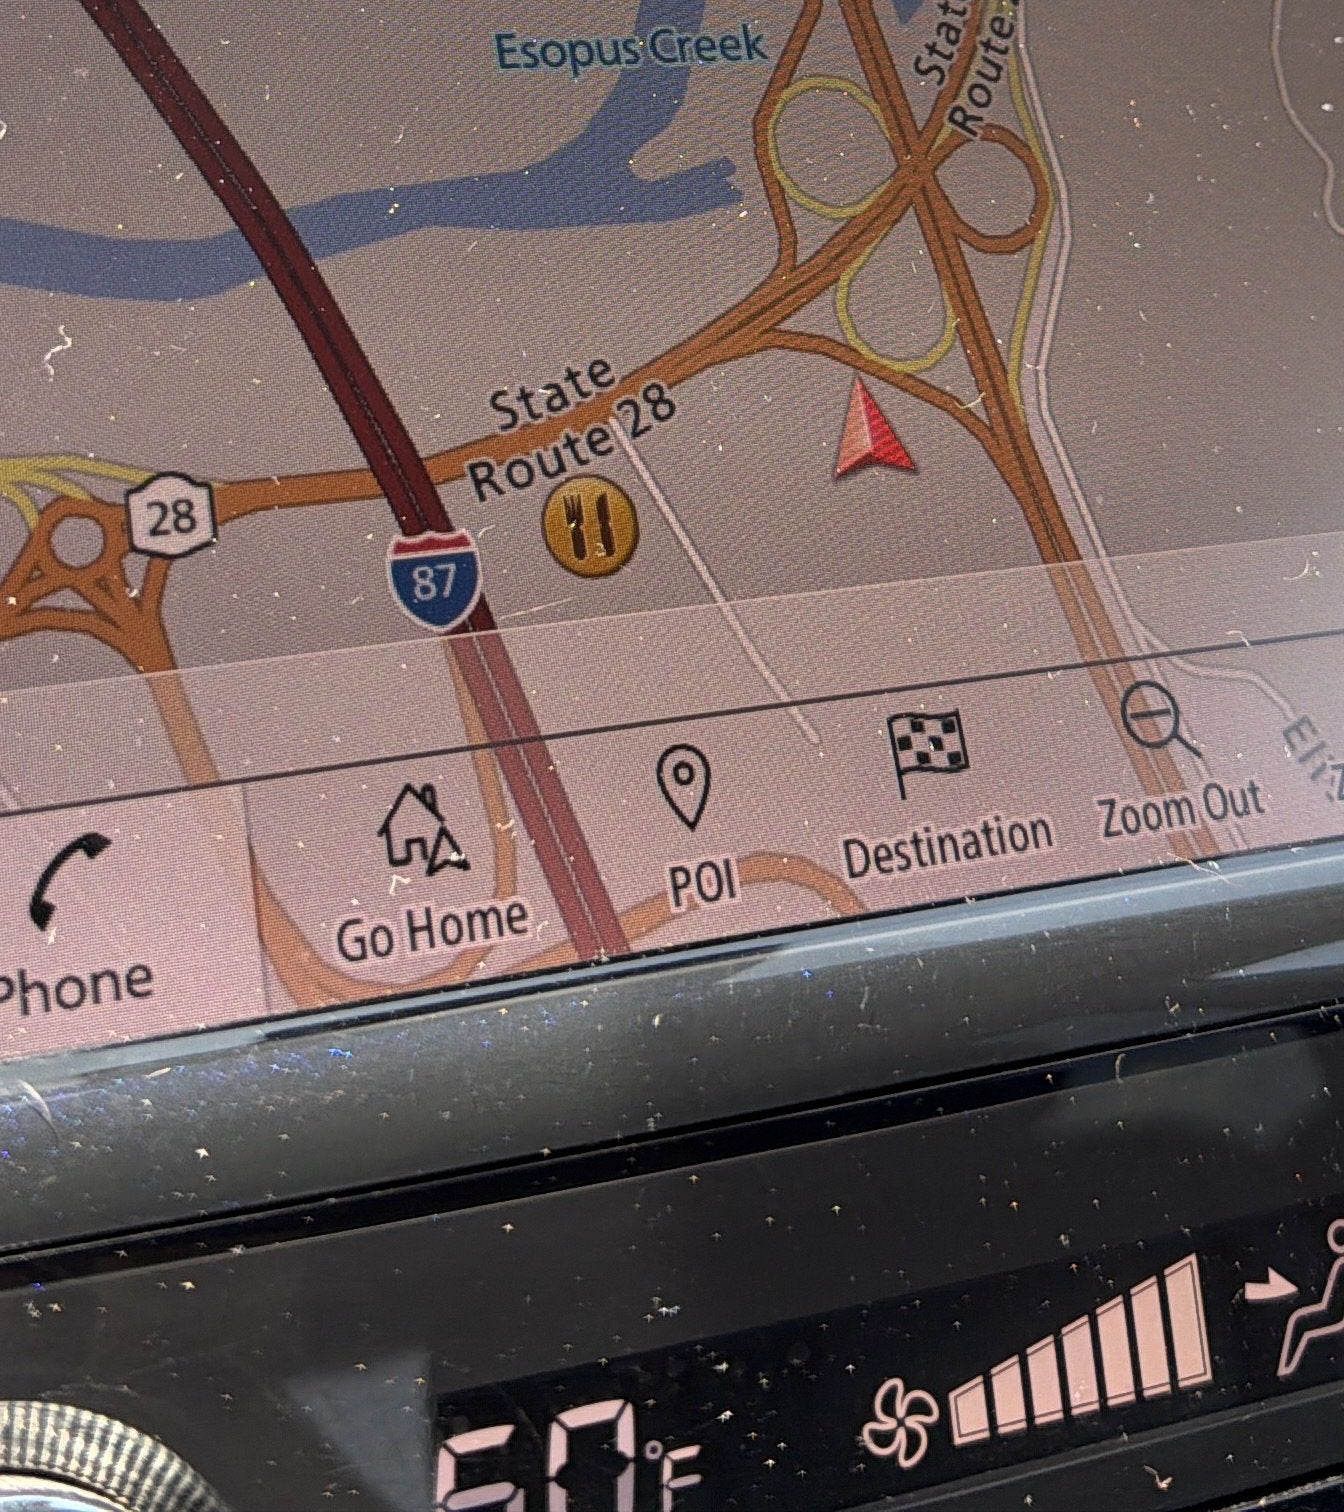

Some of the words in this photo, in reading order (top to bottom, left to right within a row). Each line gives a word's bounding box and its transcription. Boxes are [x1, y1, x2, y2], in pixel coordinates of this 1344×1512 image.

[495, 30, 640, 78] Esopus
[647, 24, 767, 65] Creek
[948, 10, 1015, 137] Route
[489, 356, 616, 432] State
[467, 426, 613, 504] Route
[617, 383, 678, 442] 28
[146, 499, 197, 536] 28
[411, 566, 456, 600] 87
[1102, 791, 1196, 838] Zoom
[1202, 778, 1266, 823] Out
[843, 813, 1053, 879] Destination
[669, 864, 737, 909] POI
[336, 916, 394, 963] Go
[406, 898, 530, 954] Home
